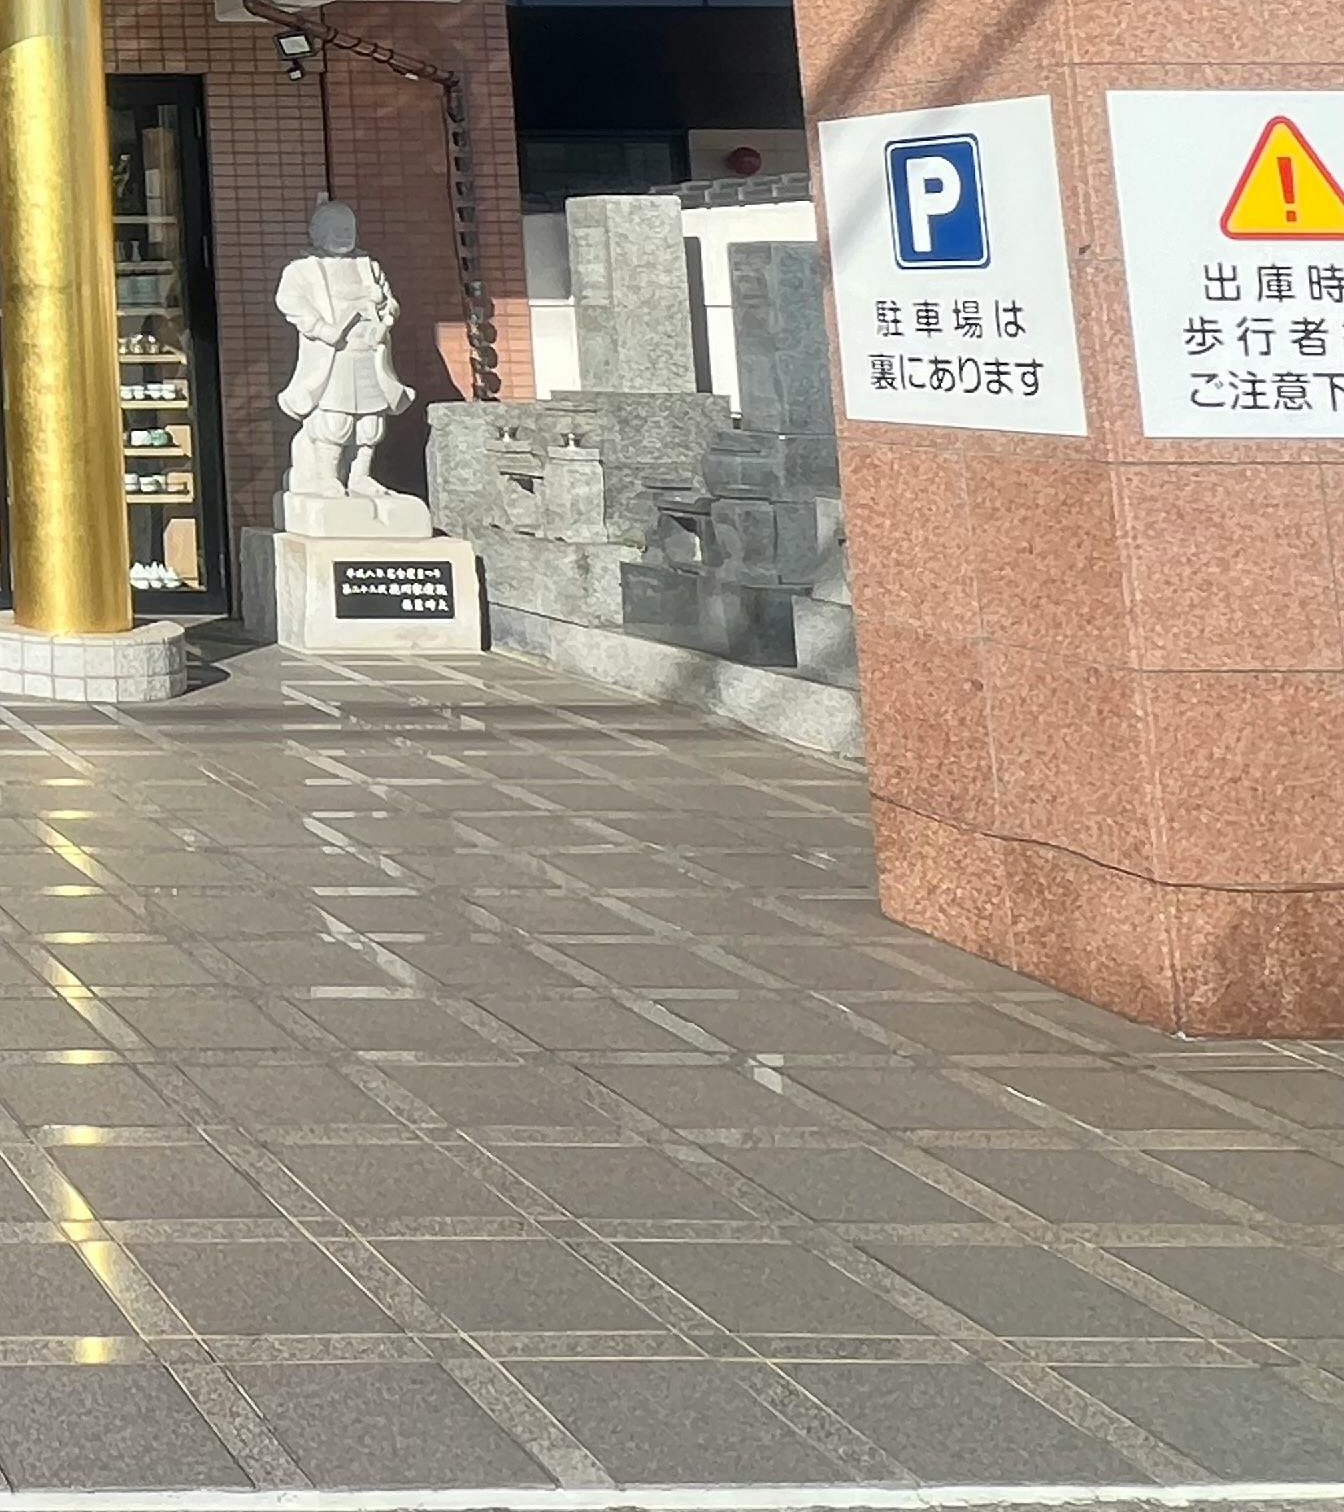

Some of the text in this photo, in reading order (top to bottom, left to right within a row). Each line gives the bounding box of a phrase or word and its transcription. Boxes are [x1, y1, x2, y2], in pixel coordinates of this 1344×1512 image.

[906, 156, 961, 253] P
[1203, 262, 1344, 303] 出庫時
[875, 299, 1027, 340] 駐車場は
[1182, 316, 1344, 357] 歩行者
[868, 352, 1044, 396] 裏にあります
[1189, 371, 1344, 412] ご注意下
